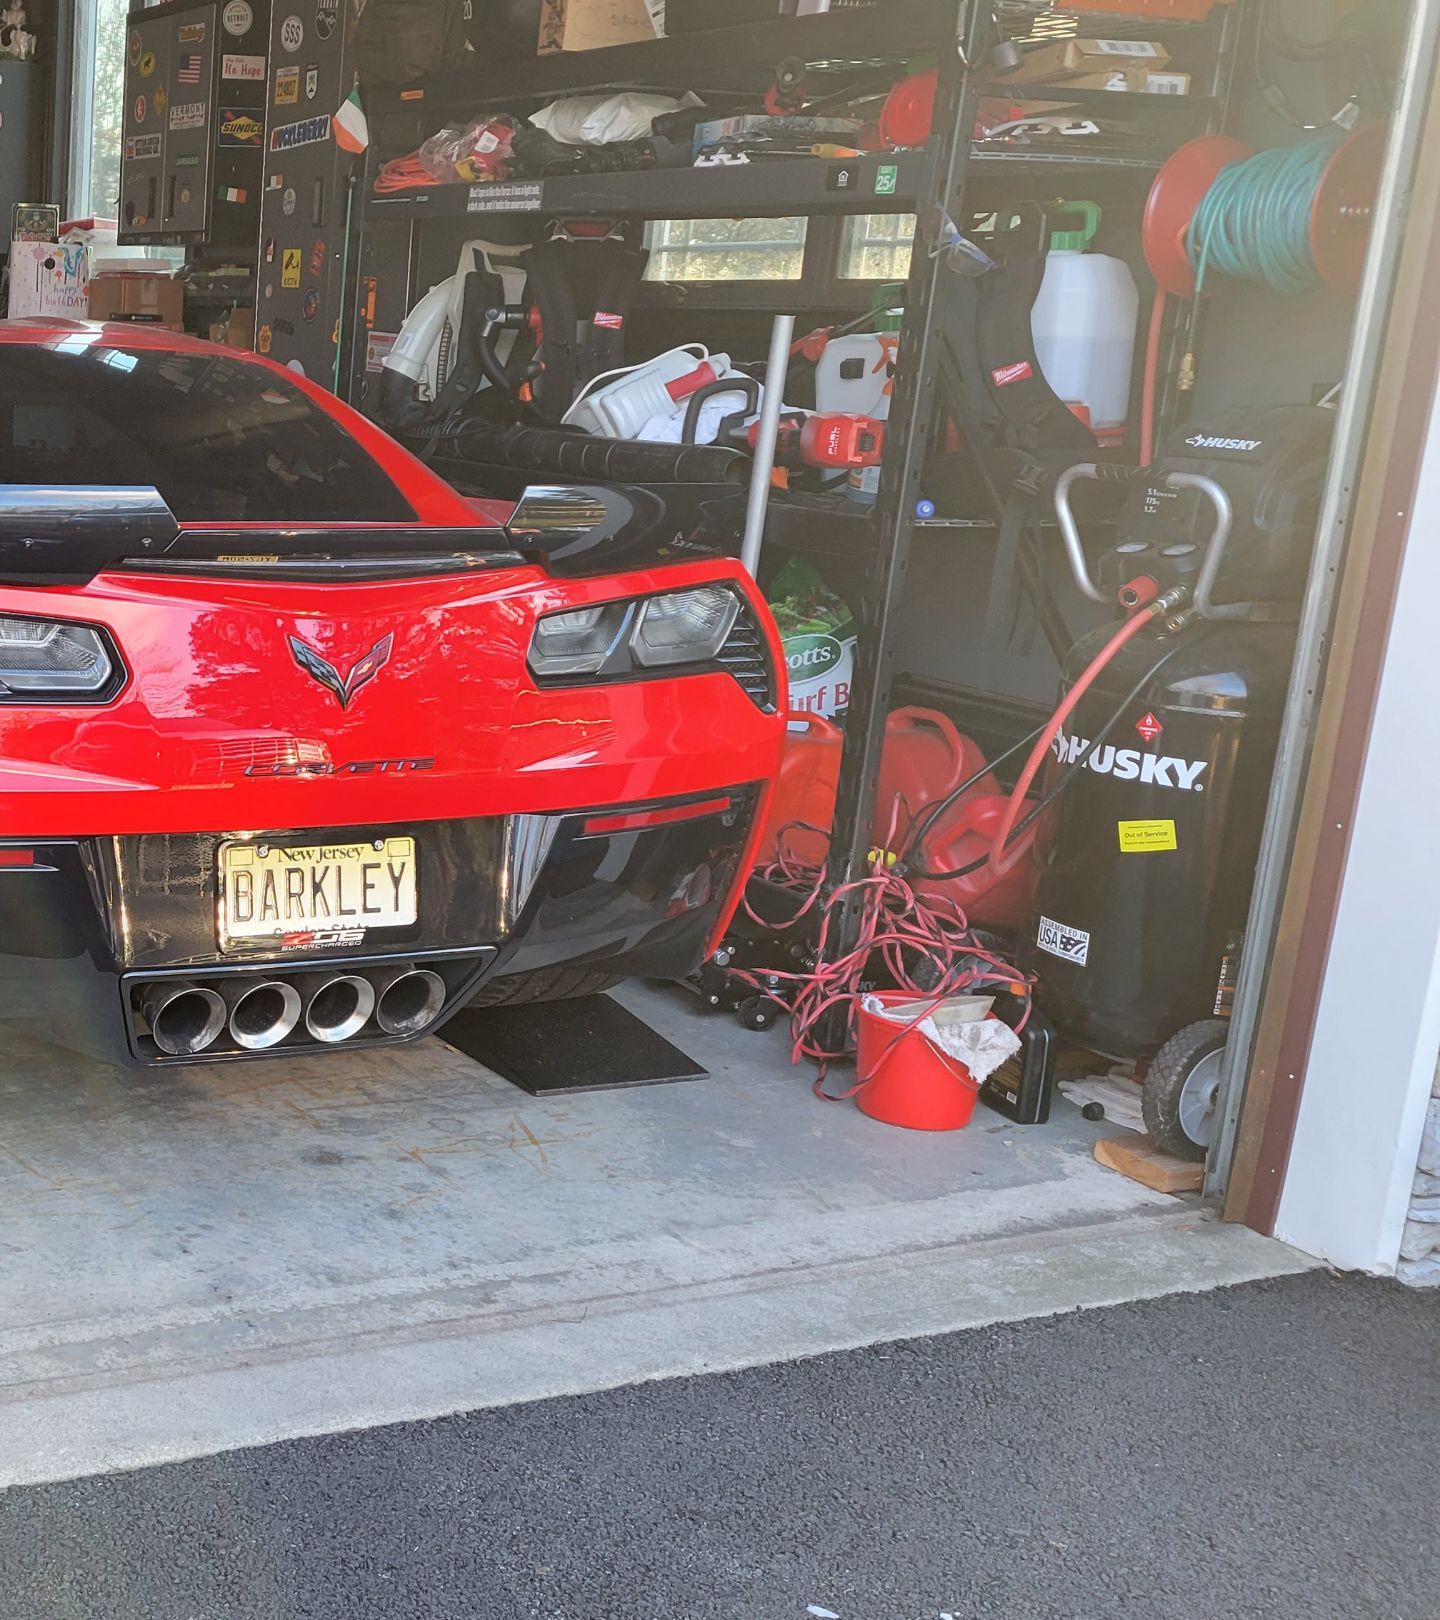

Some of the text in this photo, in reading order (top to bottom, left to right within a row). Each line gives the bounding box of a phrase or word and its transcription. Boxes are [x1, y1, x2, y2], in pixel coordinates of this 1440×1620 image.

[284, 23, 301, 44] SSS
[224, 62, 261, 78] No Hope
[170, 103, 205, 117] VERMONT
[222, 123, 263, 134] SUNOCO
[54, 284, 77, 295] happy
[994, 361, 1030, 383] Milwaukee
[827, 426, 838, 455] FUEL
[1203, 436, 1263, 452] HUSKY
[785, 644, 832, 669] otts
[788, 685, 828, 712] urf
[245, 757, 436, 777] CORVETTE
[1067, 735, 1208, 790] HUSKY
[1144, 830, 1168, 838] Service
[277, 845, 366, 864] New Jersey
[232, 861, 407, 924] BARKLEY
[281, 928, 367, 946] Z06
[1038, 924, 1058, 948] USA
[1040, 917, 1089, 941] ASSEMBLED IN
[281, 940, 363, 952] SUPERCHARGED
